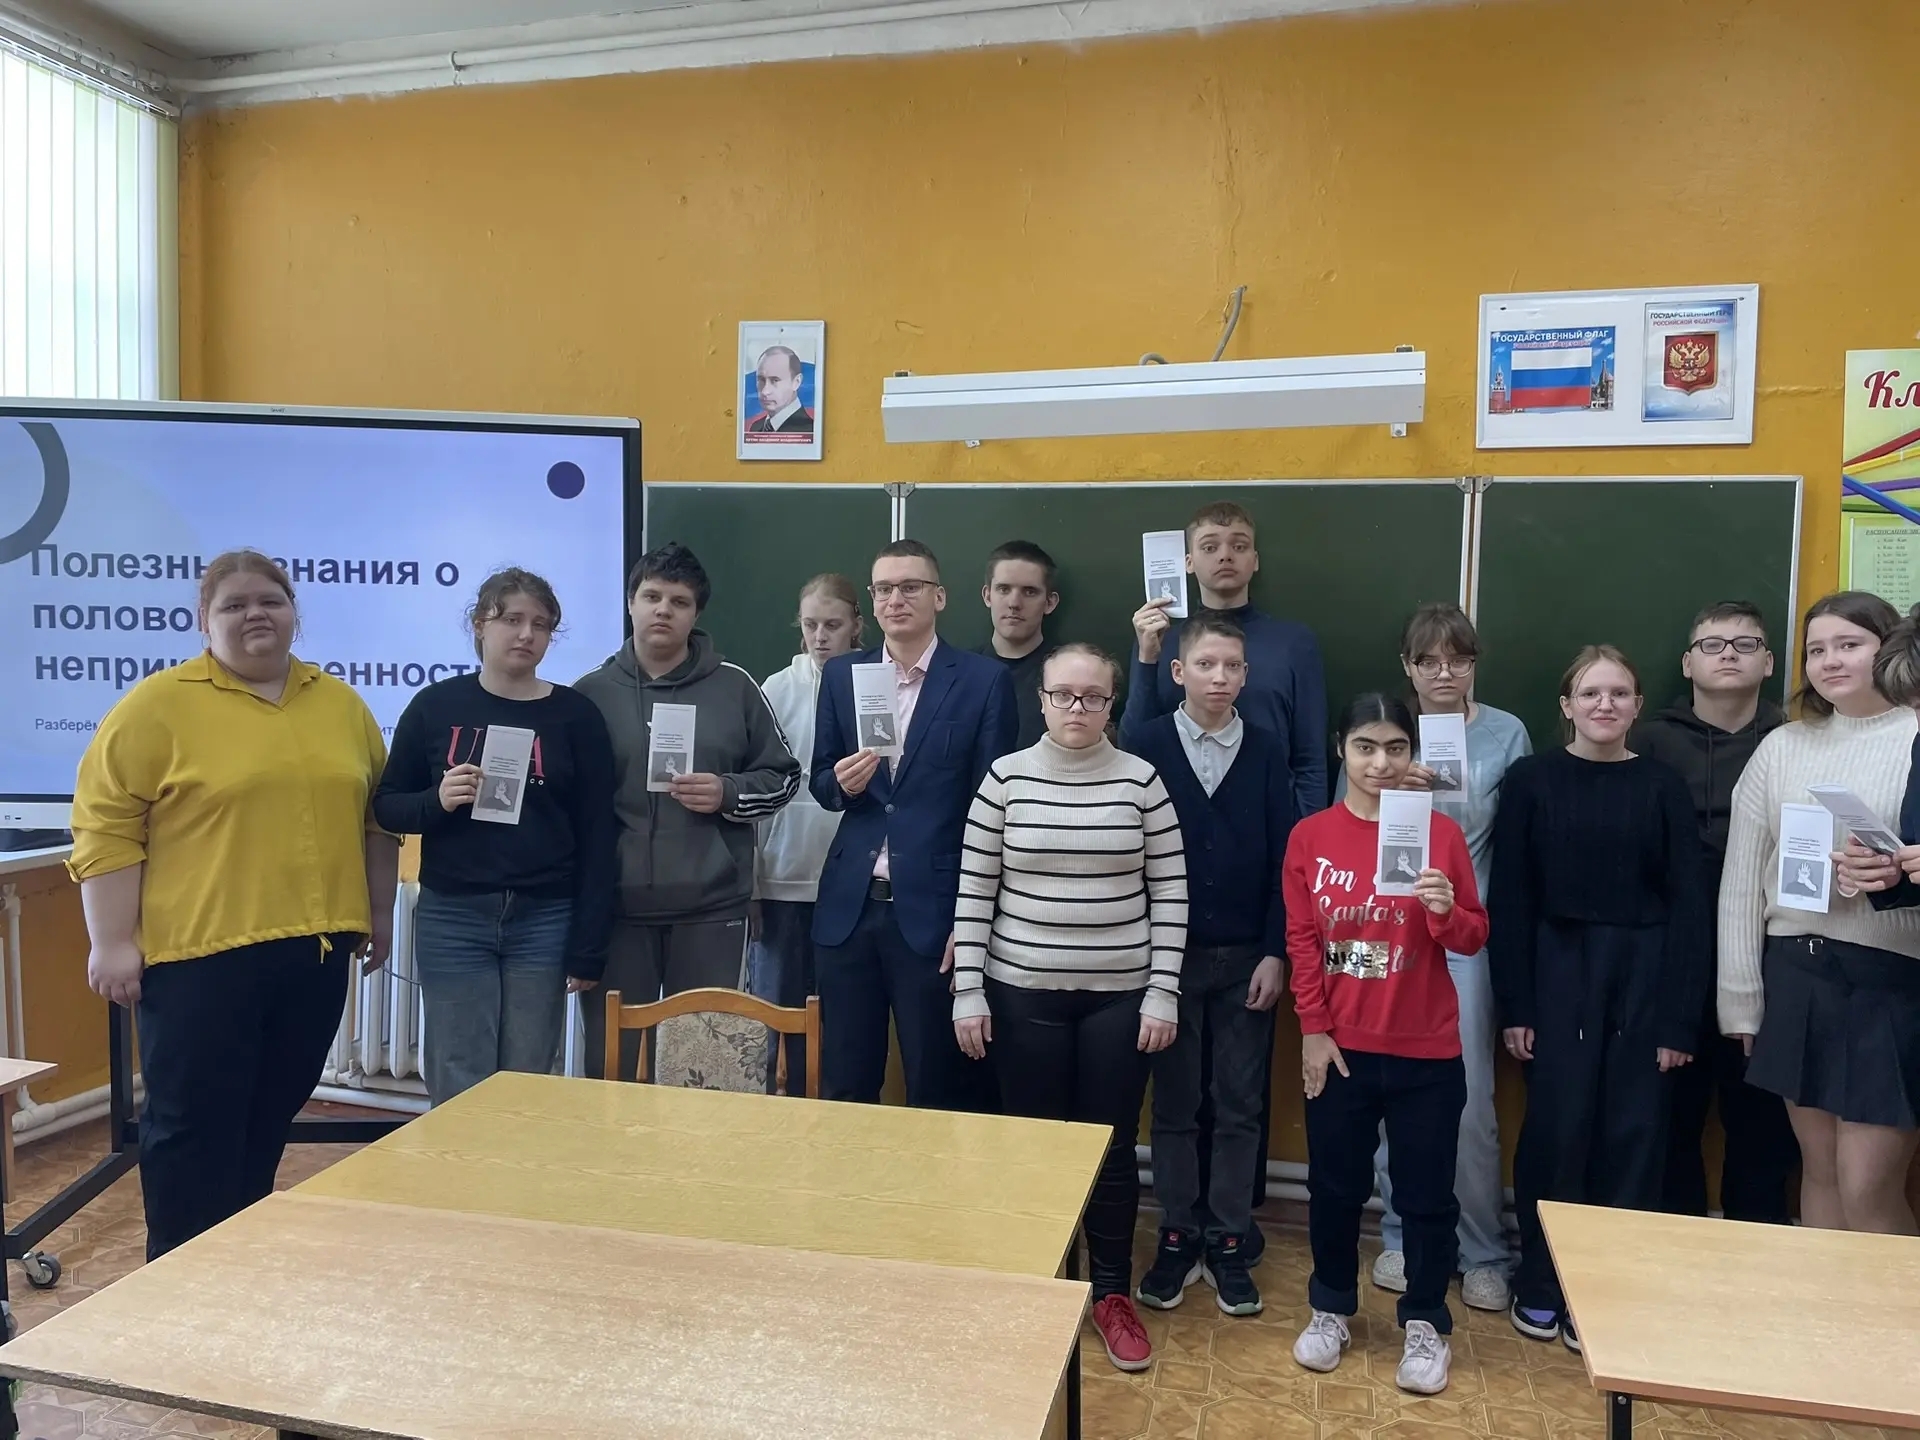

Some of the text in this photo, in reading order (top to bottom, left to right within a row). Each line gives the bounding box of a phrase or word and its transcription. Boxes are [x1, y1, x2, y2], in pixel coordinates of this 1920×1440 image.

[1496, 330, 1609, 342] ГОСУДАРСТВЕННЫЙ ФЛАГ
[31, 543, 208, 580] Полезн
[434, 561, 460, 587] о
[33, 604, 203, 632] полово
[447, 726, 545, 777] UA
[1313, 857, 1358, 893] I'm
[1319, 894, 1409, 932] Santa's
[1326, 951, 1373, 968] NICE
